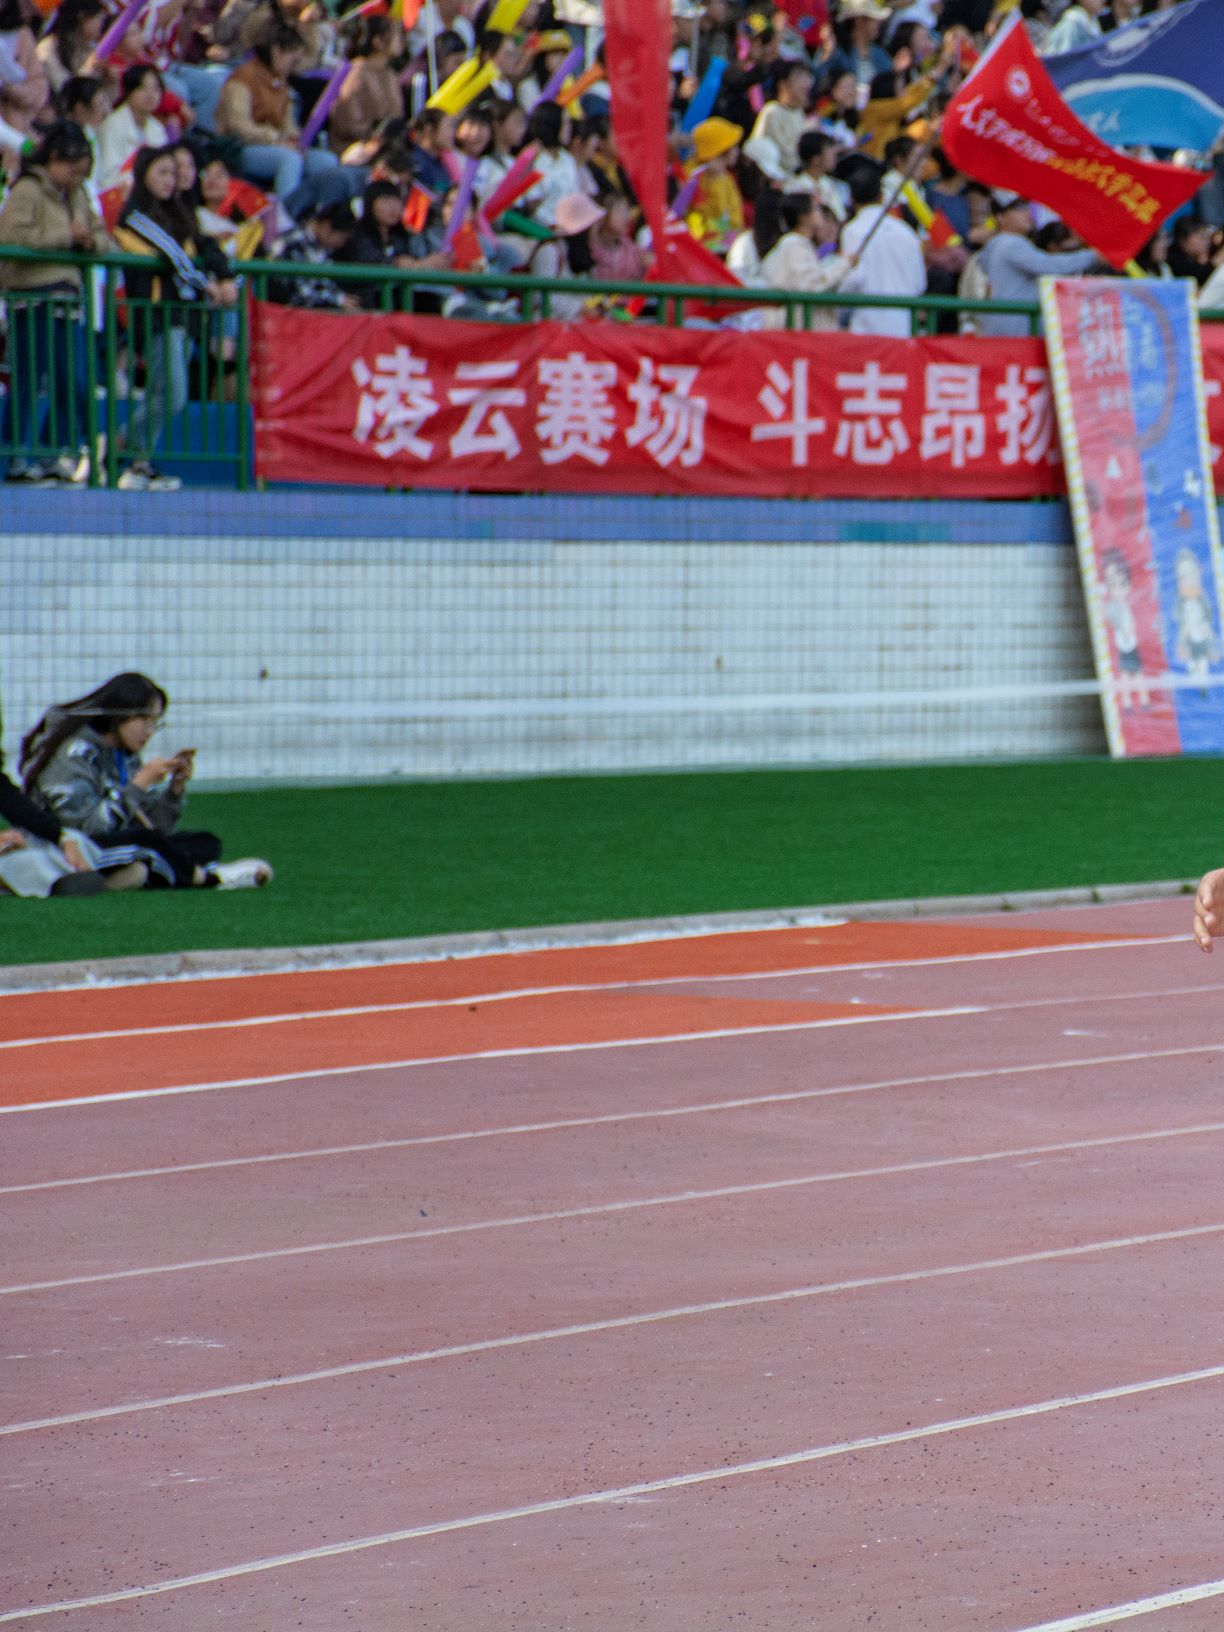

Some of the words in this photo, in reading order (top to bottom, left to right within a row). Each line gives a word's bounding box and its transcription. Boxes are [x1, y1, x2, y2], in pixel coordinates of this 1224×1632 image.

[351, 345, 708, 468] 凌云赛场
[750, 357, 1057, 468] 斗志昂扬
